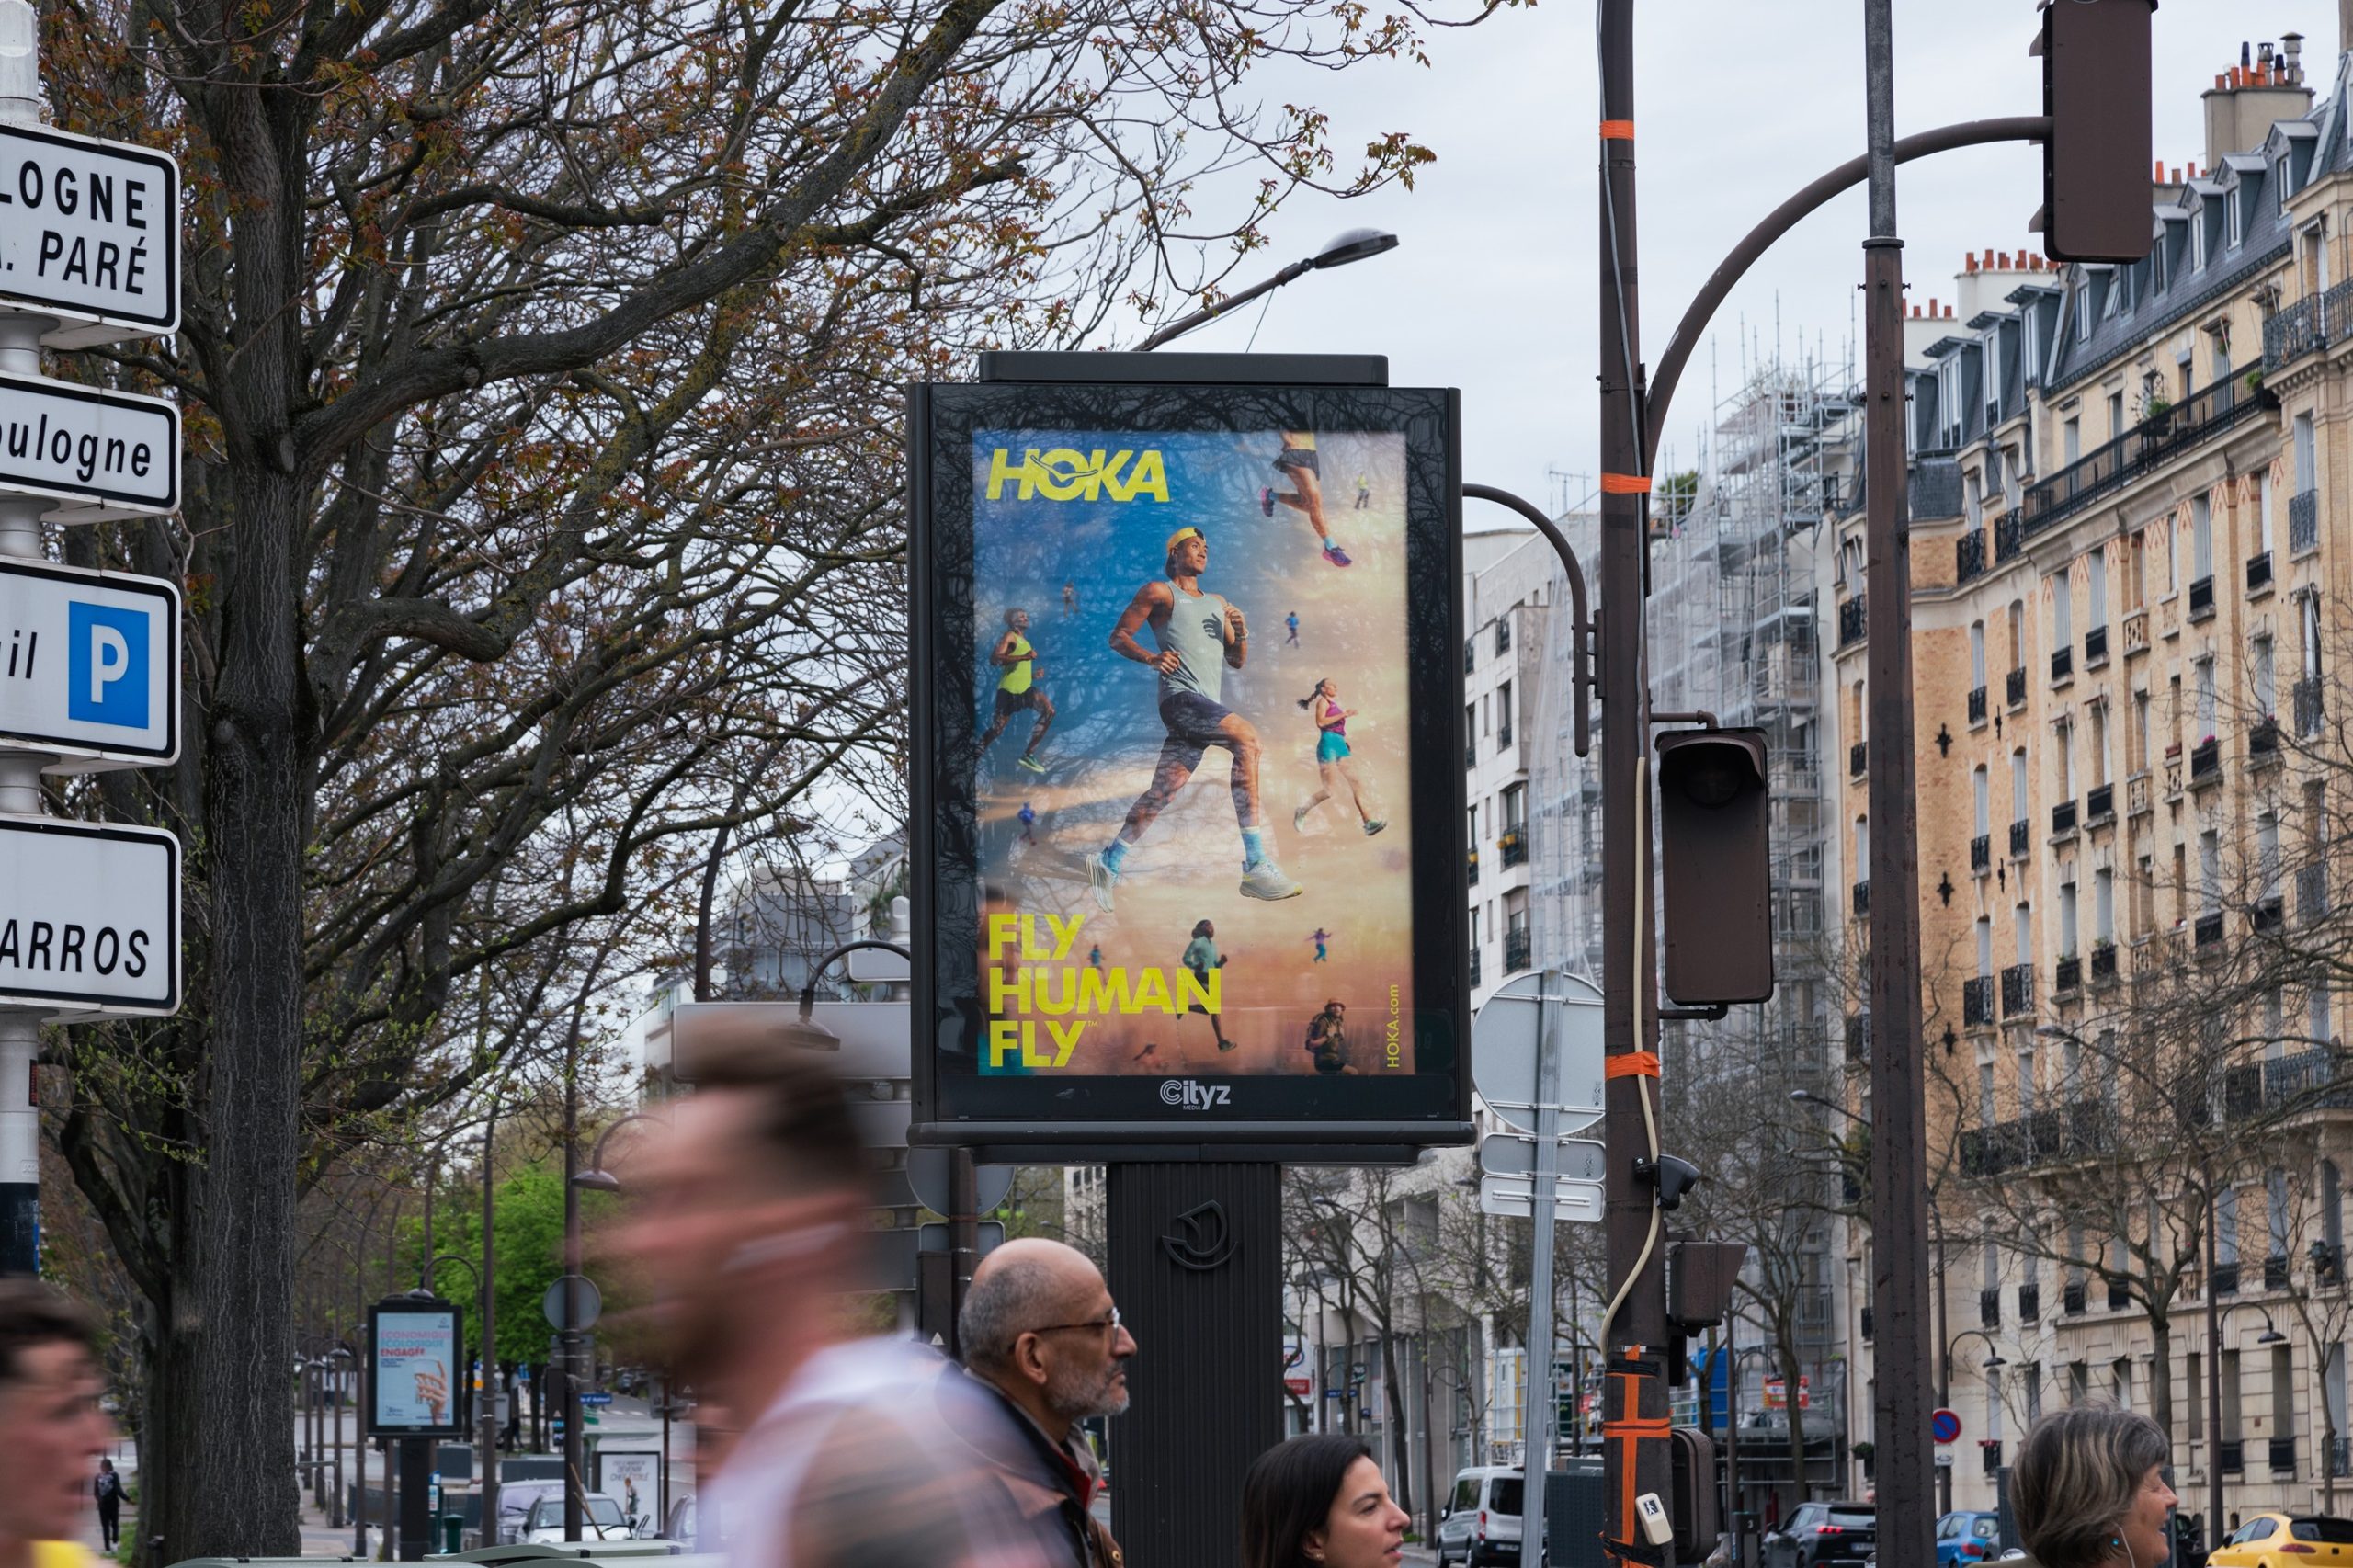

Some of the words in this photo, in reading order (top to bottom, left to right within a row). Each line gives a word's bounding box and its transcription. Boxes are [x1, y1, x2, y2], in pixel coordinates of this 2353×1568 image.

[38, 230, 148, 295] PARÉ
[0, 414, 151, 482] ulogne
[985, 448, 1170, 502] HOKA
[0, 629, 38, 679] il
[0, 919, 150, 978] ARROS
[988, 914, 1086, 960] FLY
[989, 967, 1222, 1015] HUMAN
[1386, 984, 1400, 1068] HOKA.com
[1159, 1079, 1231, 1110] Cityz
